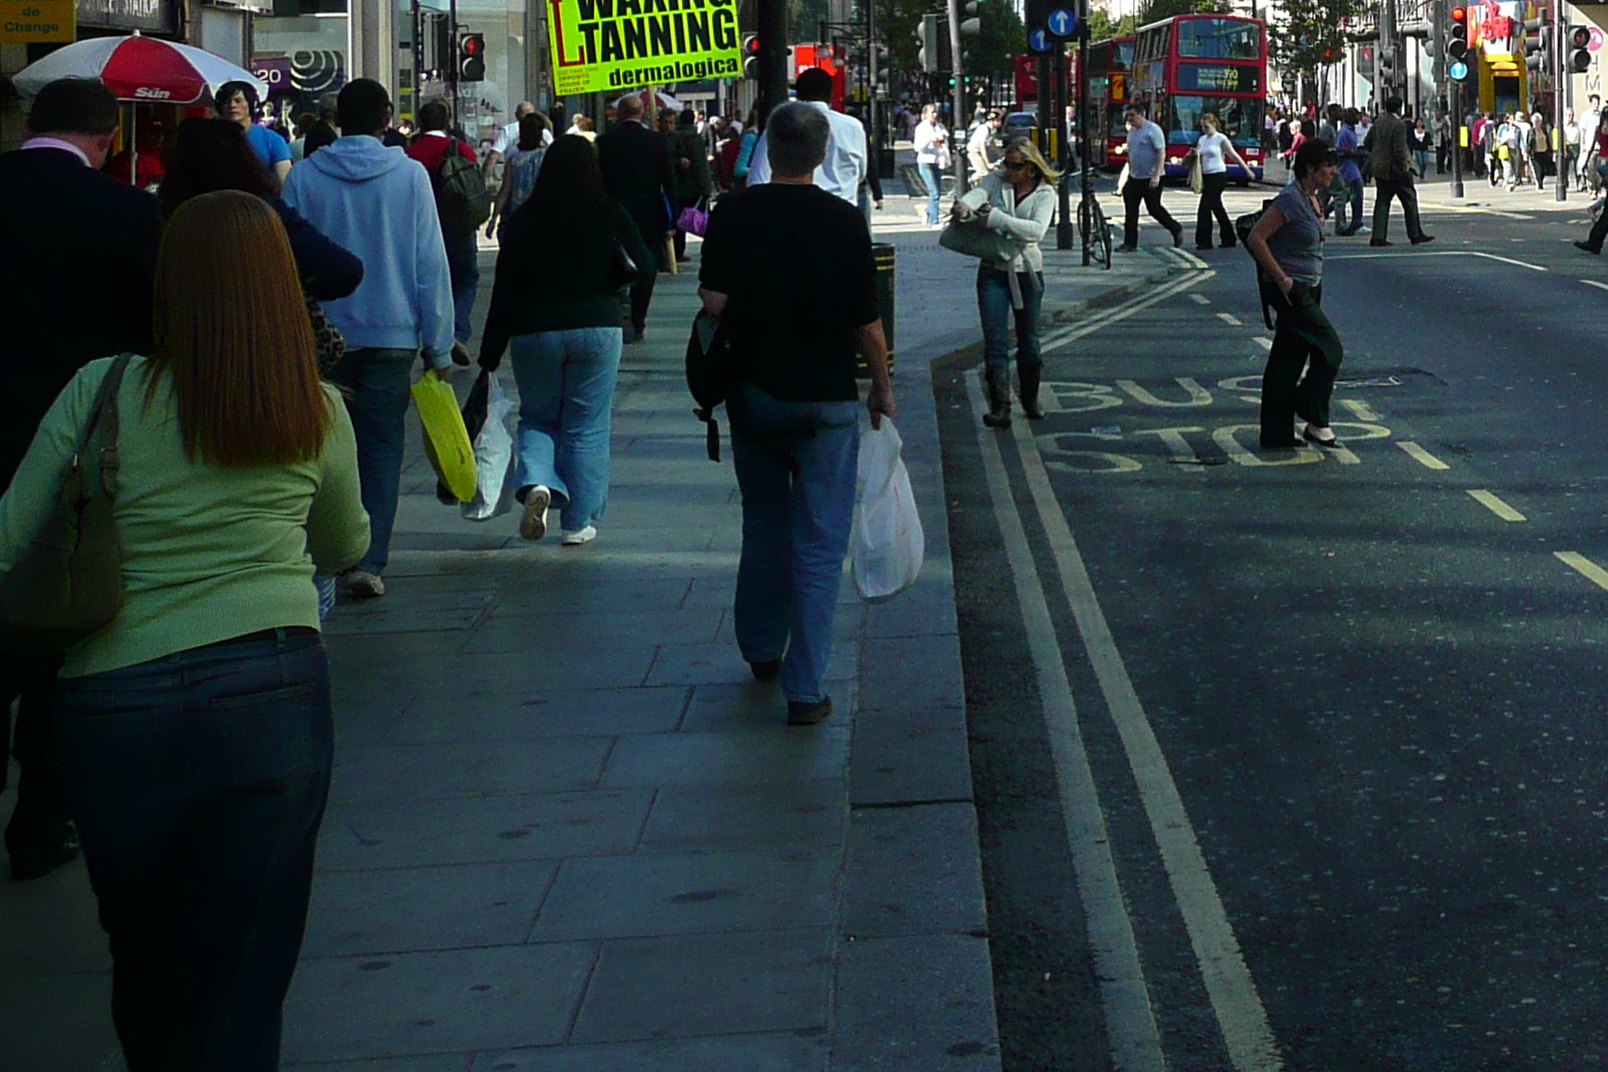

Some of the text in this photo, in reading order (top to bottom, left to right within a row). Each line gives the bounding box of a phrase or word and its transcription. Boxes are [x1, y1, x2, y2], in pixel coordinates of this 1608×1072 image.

[22, 7, 41, 16] de
[4, 22, 59, 34] Change
[578, 8, 738, 65] TANNING
[609, 57, 739, 87] dermalogica
